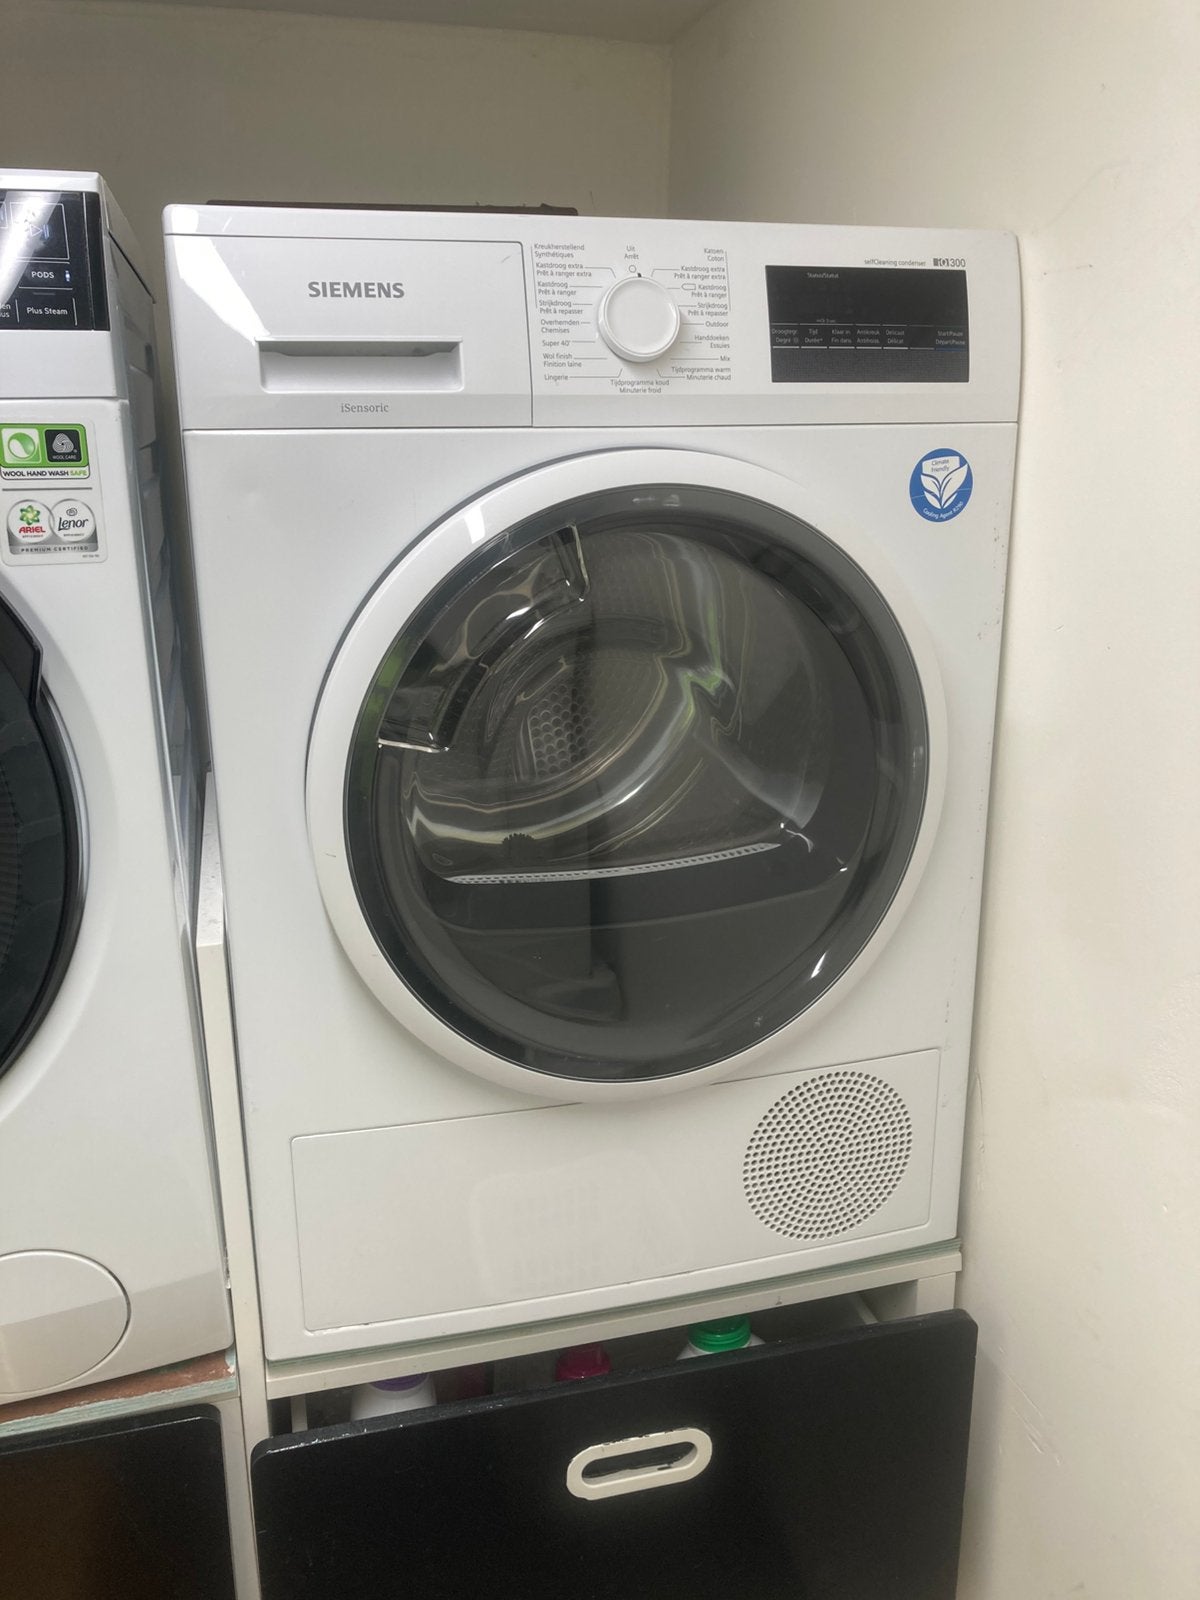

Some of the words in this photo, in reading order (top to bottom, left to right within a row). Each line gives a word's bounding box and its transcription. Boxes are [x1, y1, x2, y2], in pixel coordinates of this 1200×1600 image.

[308, 282, 405, 298] SIEMENS
[341, 403, 389, 413] iSensoric
[58, 516, 88, 532] Lenor
